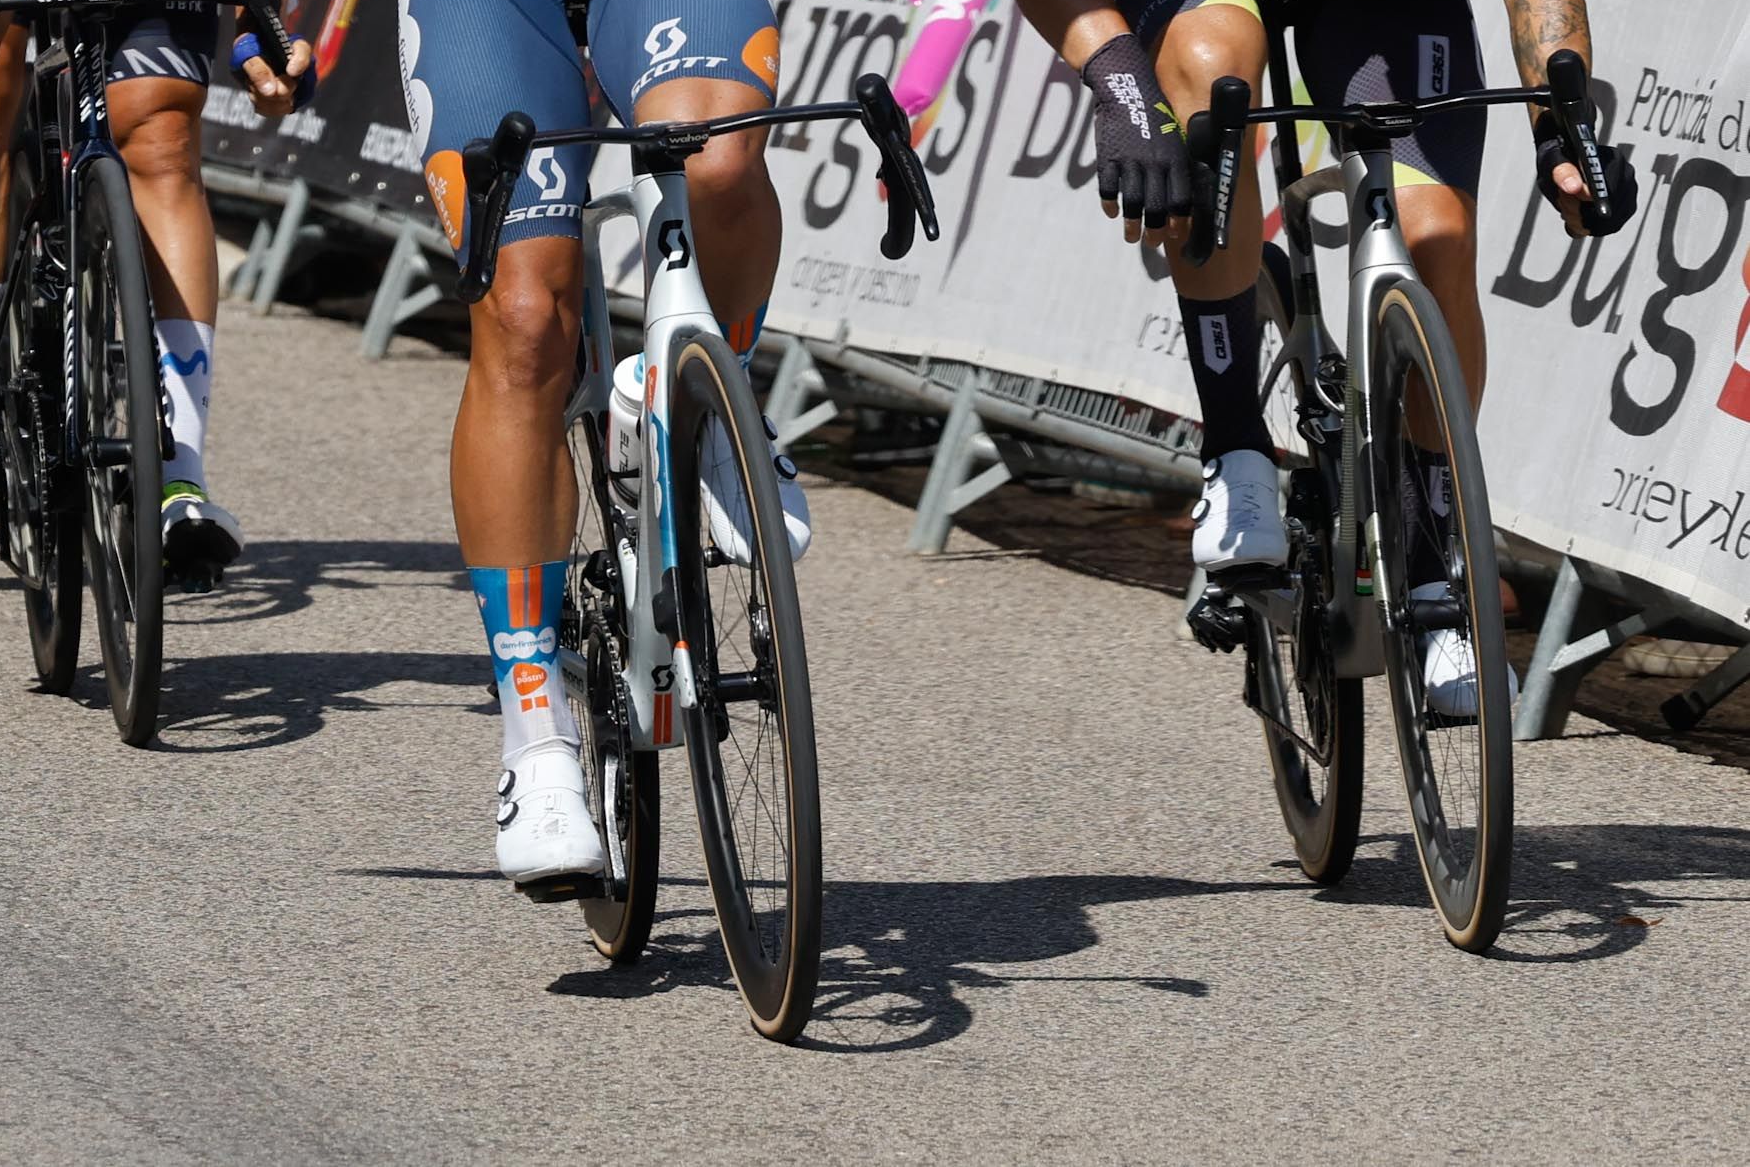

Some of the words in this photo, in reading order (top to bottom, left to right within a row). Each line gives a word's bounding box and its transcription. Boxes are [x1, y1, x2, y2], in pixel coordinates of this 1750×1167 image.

[630, 56, 728, 104] SCOTT
[1103, 72, 1127, 106] TEAM
[1431, 42, 1447, 95] Q36.5
[1113, 72, 1141, 125] CYCLING
[1385, 117, 1414, 125] GARMIN
[668, 133, 710, 145] wahoo
[1576, 123, 1609, 199] SRAM
[1213, 149, 1236, 229] SRAM
[1214, 320, 1227, 361] Q36.5
